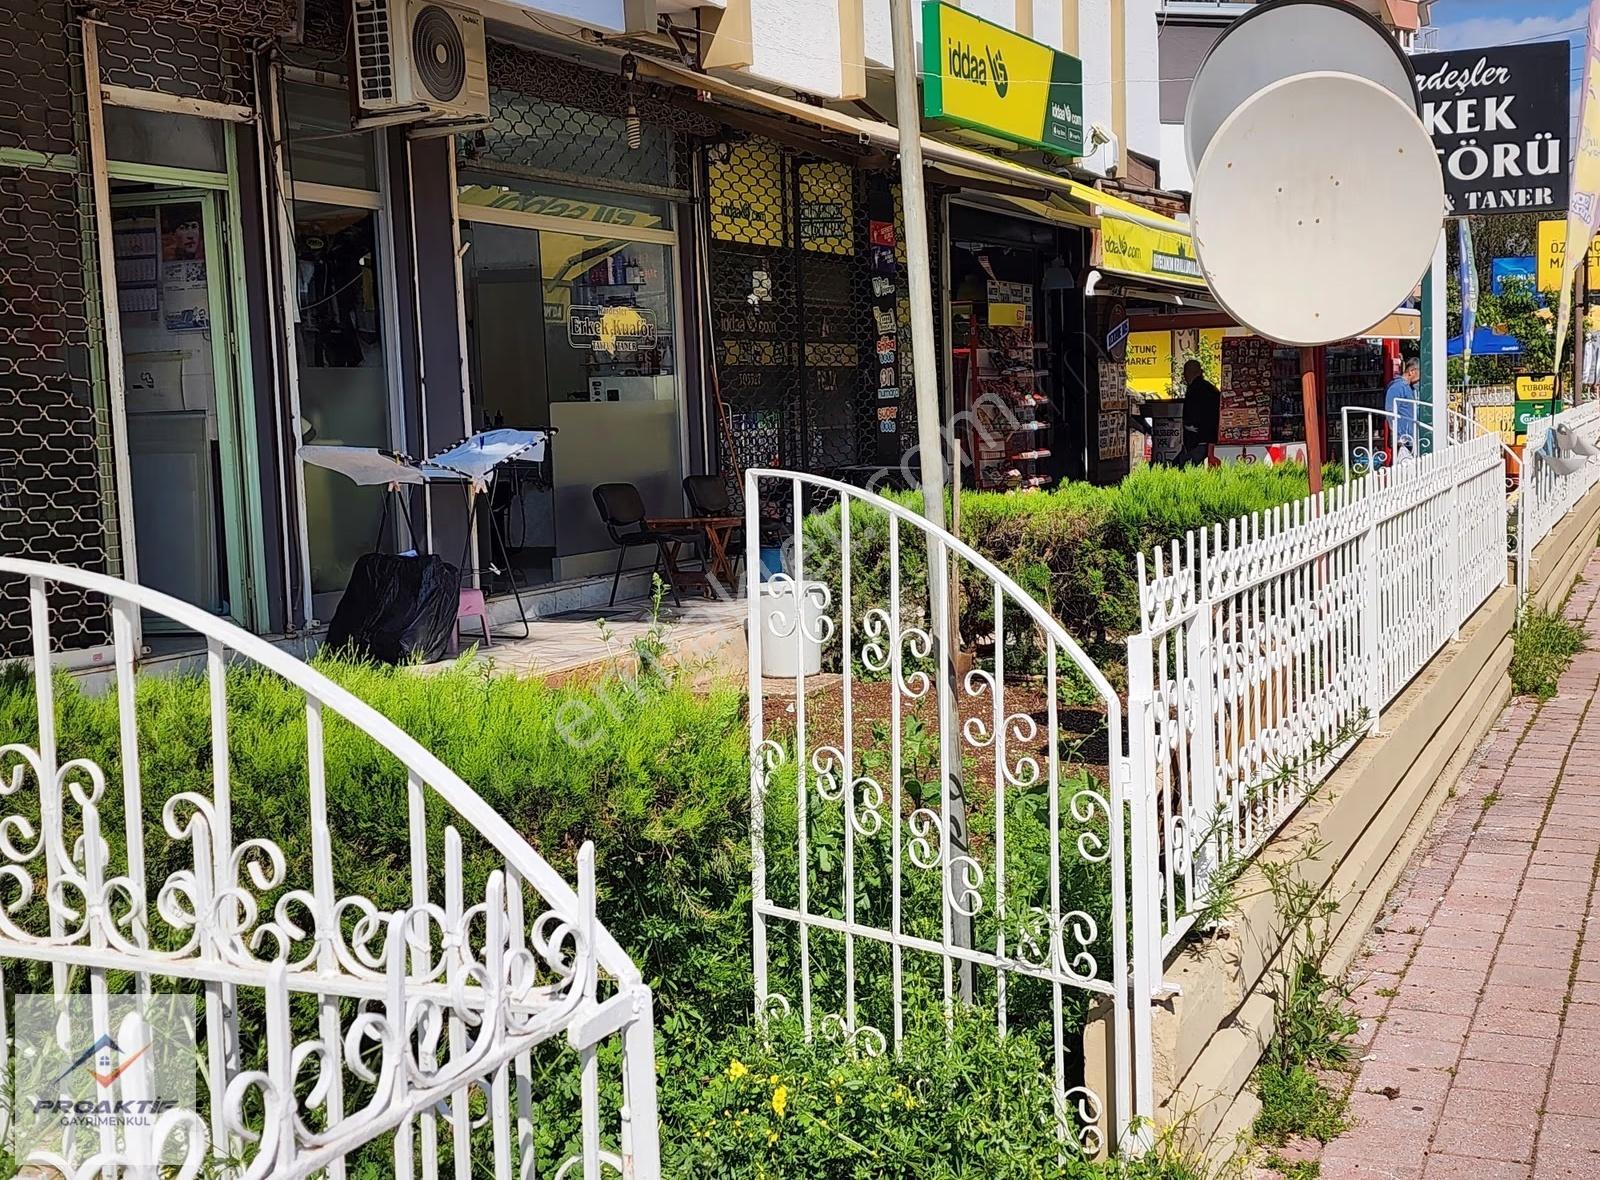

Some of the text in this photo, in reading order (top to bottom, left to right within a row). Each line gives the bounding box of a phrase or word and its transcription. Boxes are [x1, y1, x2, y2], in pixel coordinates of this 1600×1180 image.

[948, 37, 987, 86] iddaa
[1465, 187, 1554, 210] TANER
[571, 317, 609, 336] Erkek
[1129, 345, 1157, 355] ZTUNÇ
